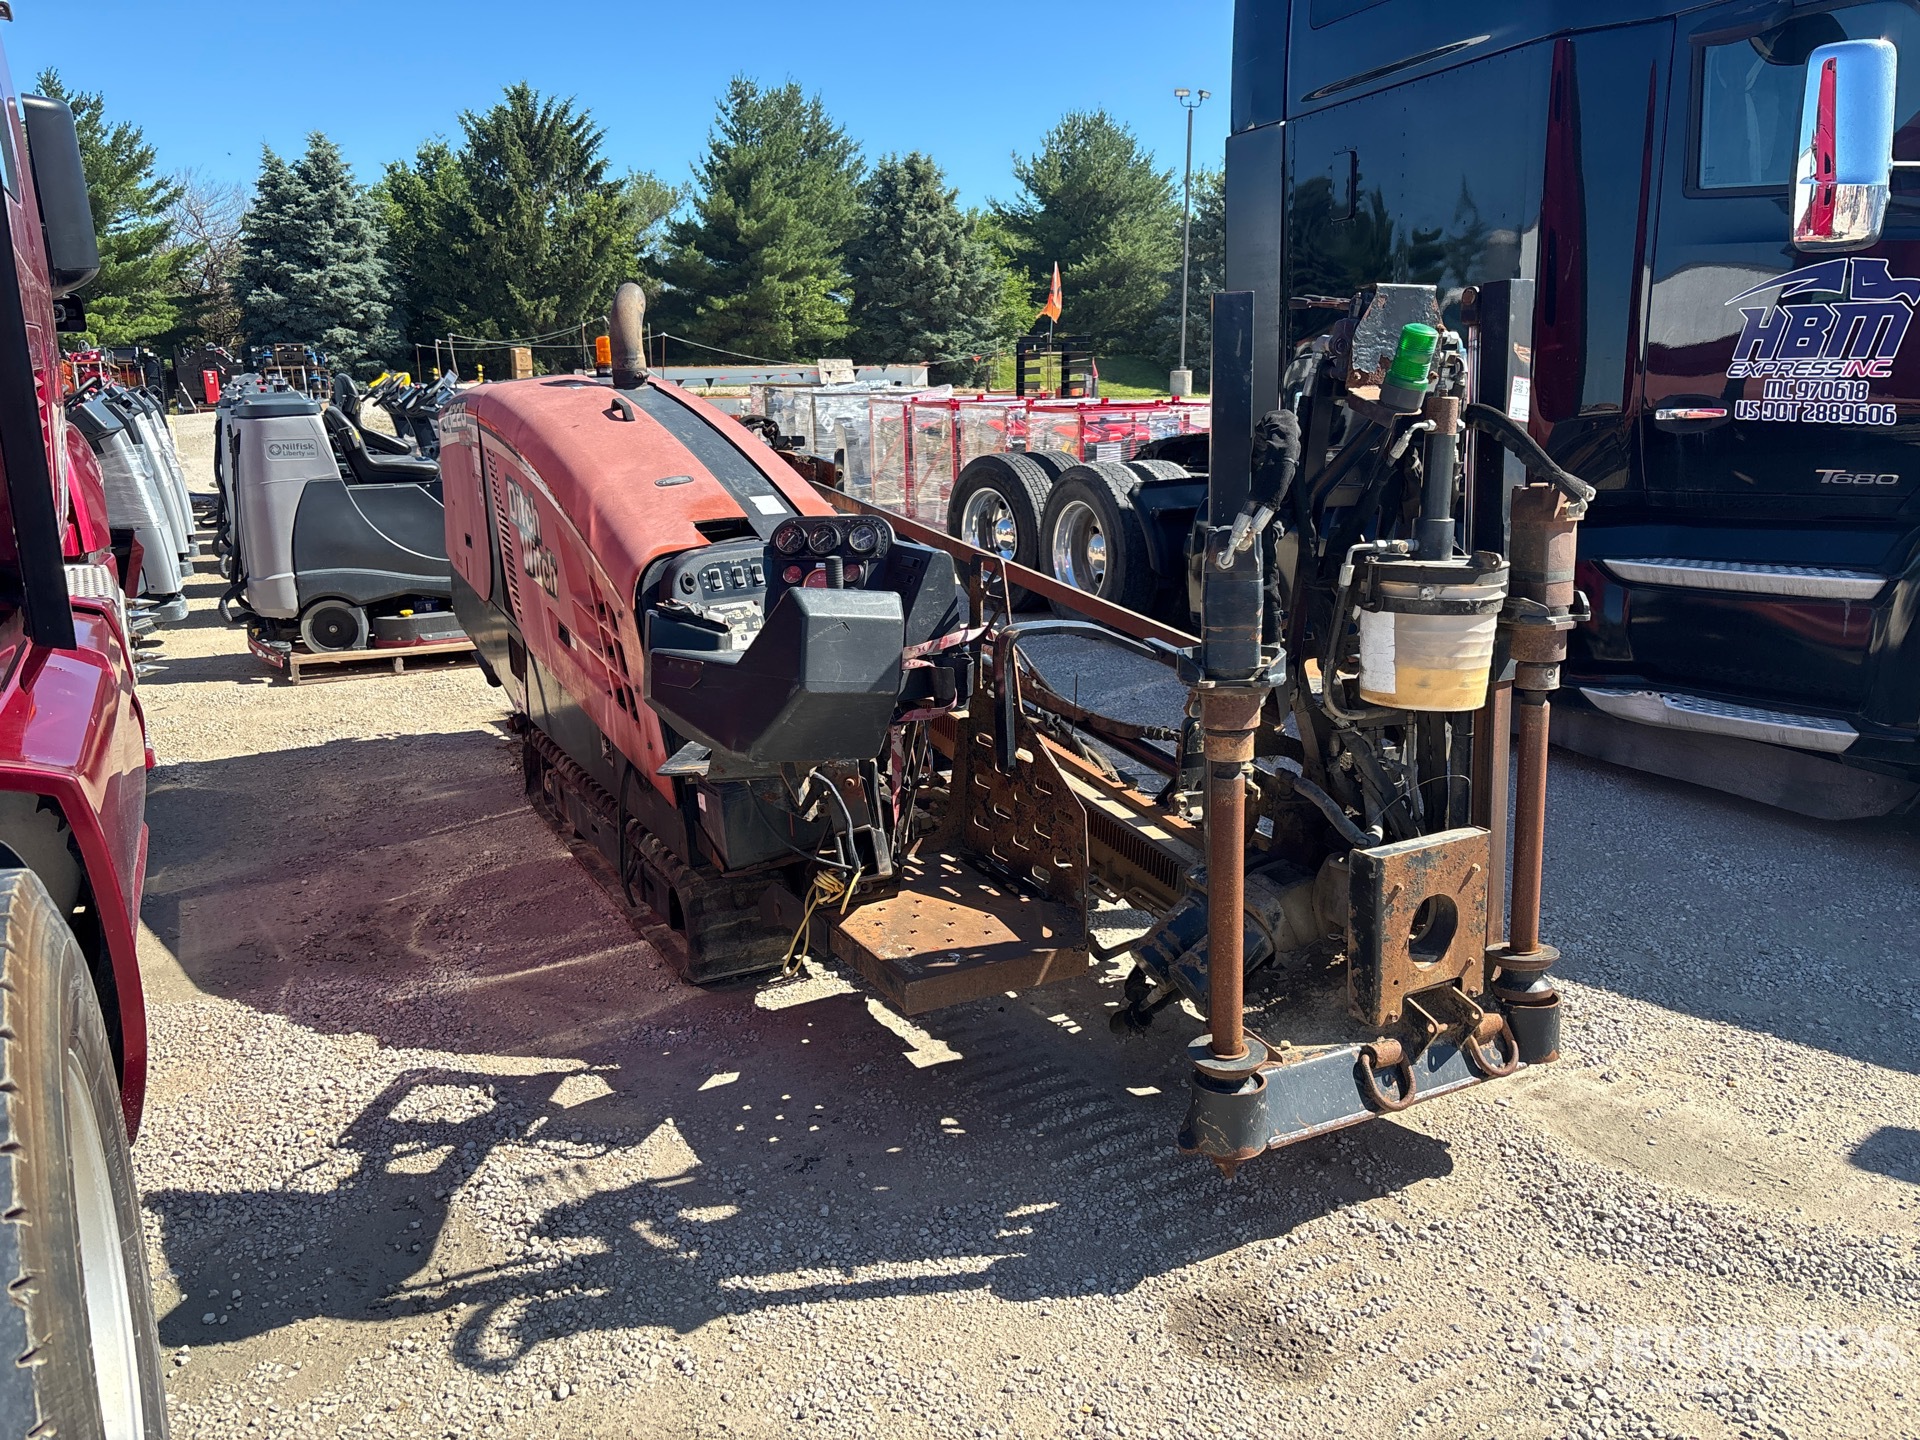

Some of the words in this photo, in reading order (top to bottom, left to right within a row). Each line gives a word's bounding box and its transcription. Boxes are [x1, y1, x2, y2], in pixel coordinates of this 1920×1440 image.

[1731, 301, 1914, 361] HBM
[1763, 379, 1795, 399] MC
[1796, 380, 1870, 402] 970618
[1735, 400, 1761, 421] US
[1762, 401, 1802, 422] DOT
[1802, 403, 1897, 425] 2889606
[1815, 469, 1900, 485] T680
[506, 480, 542, 543] Ditch
[519, 528, 559, 598] Witch
